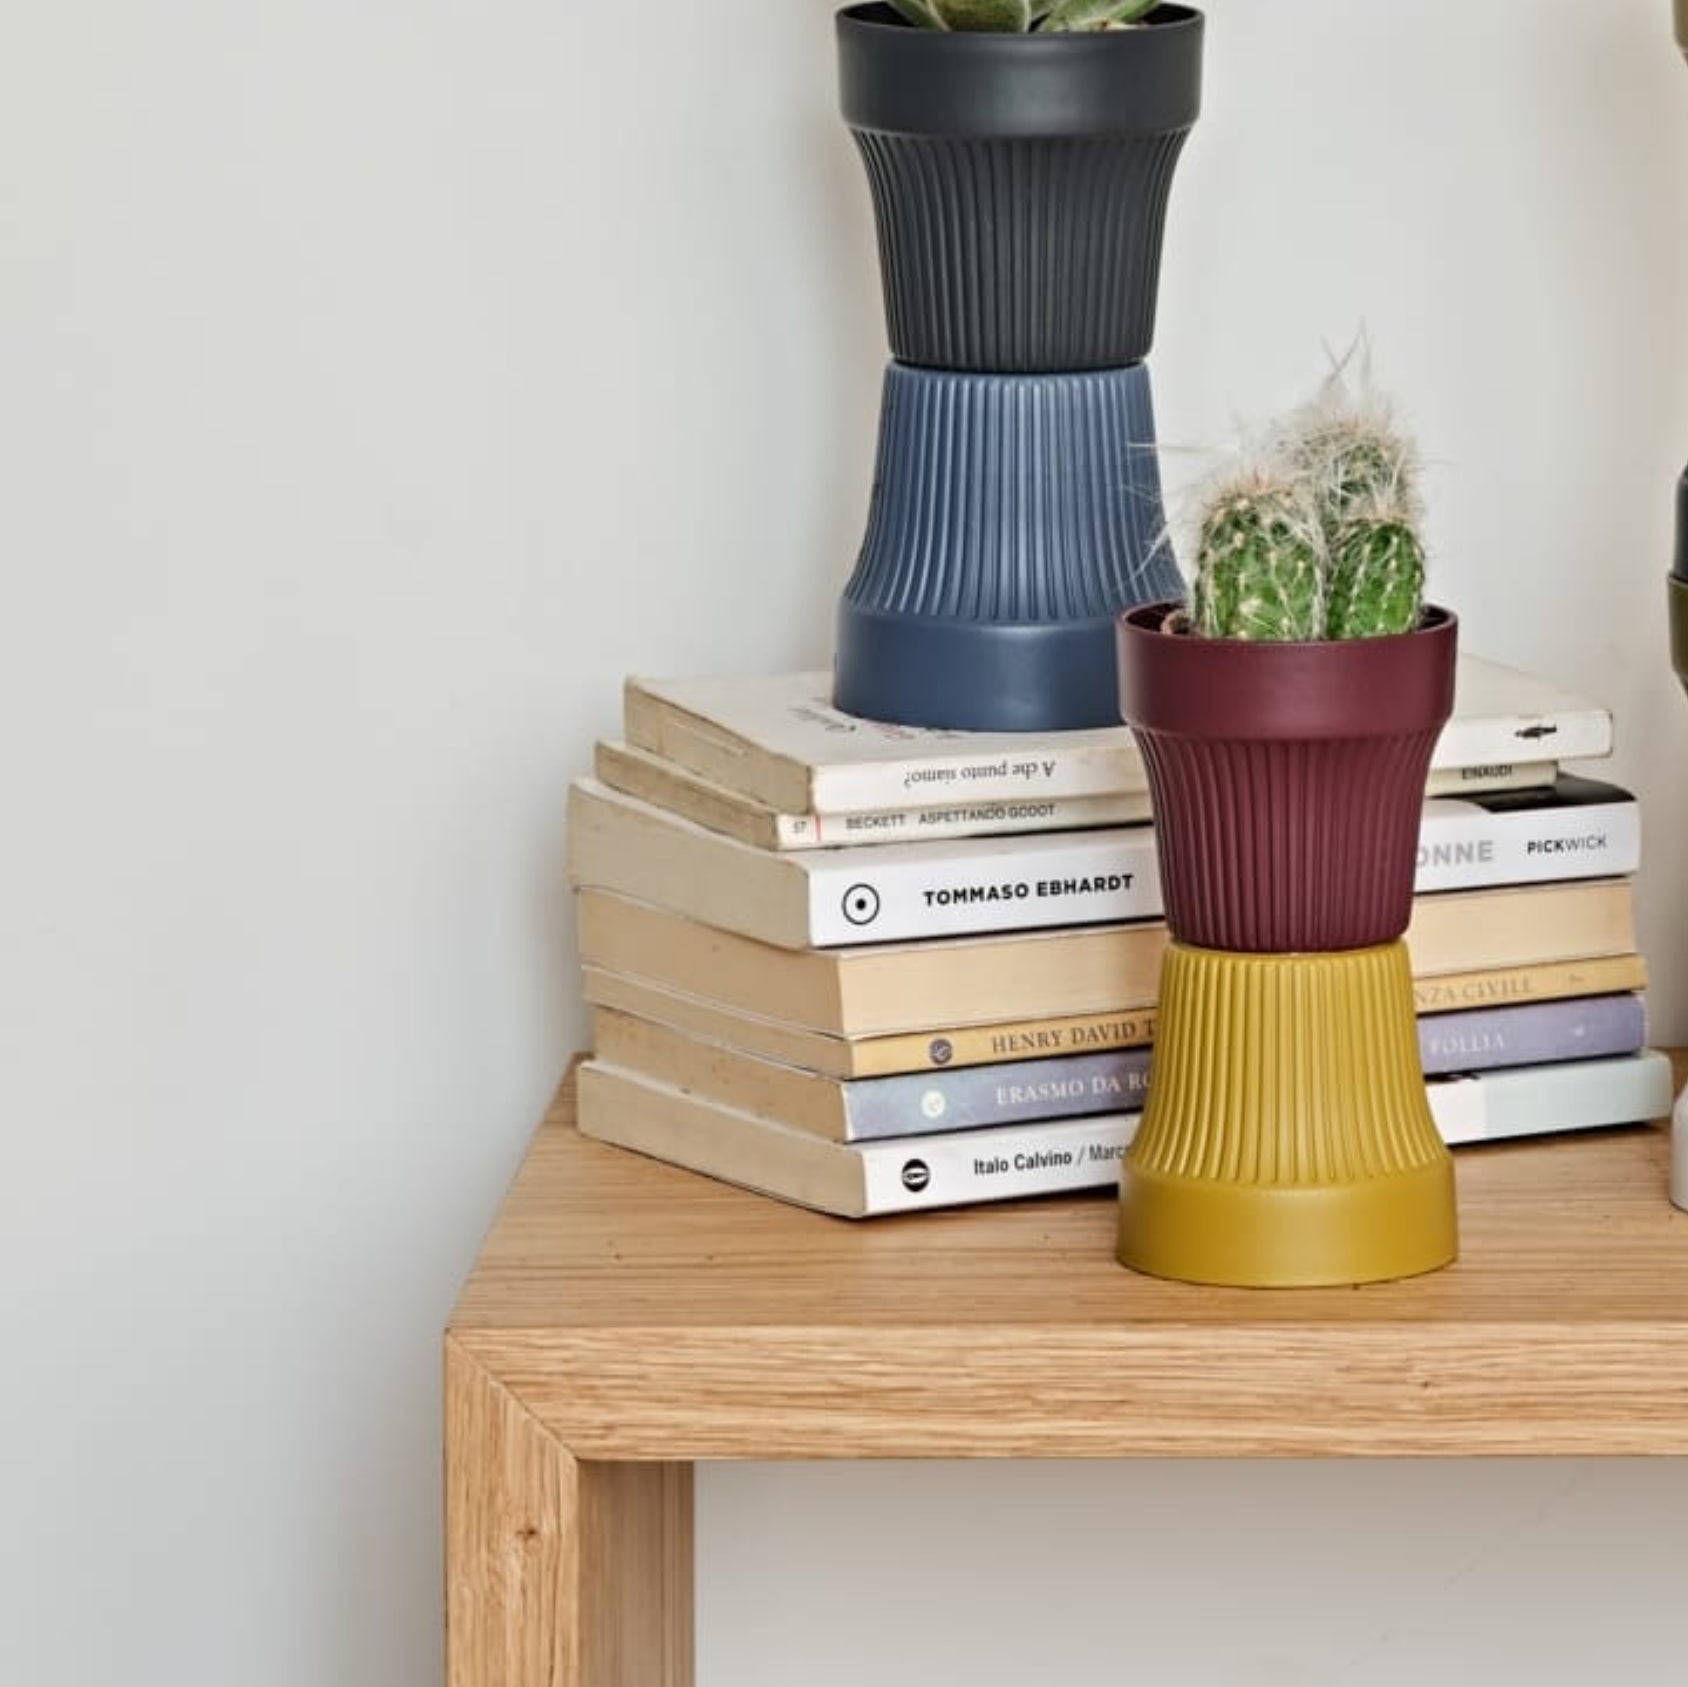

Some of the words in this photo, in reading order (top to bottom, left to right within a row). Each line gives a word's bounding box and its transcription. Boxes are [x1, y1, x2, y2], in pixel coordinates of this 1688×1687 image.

[904, 767, 957, 790] siamo?
[960, 760, 1007, 780] punto
[1012, 762, 1039, 780] che
[1043, 760, 1056, 778] A
[1462, 765, 1512, 780] EINAUDI
[845, 813, 905, 829] BECKETT
[918, 806, 1006, 825] ASPETTANDO
[1008, 803, 1056, 819] GODOT
[1527, 833, 1607, 854] PICKWICK
[923, 883, 1030, 907] TOMMASO
[1036, 872, 1135, 897] EBHARDT
[1461, 977, 1533, 999] CIVILE
[992, 1029, 1063, 1054] HENRY
[1070, 1022, 1136, 1045] DAVID
[997, 1080, 1084, 1105] ERASMO
[1092, 1076, 1121, 1094] DA
[974, 1159, 1009, 1175] Italo
[1014, 1151, 1072, 1171] Calvino
